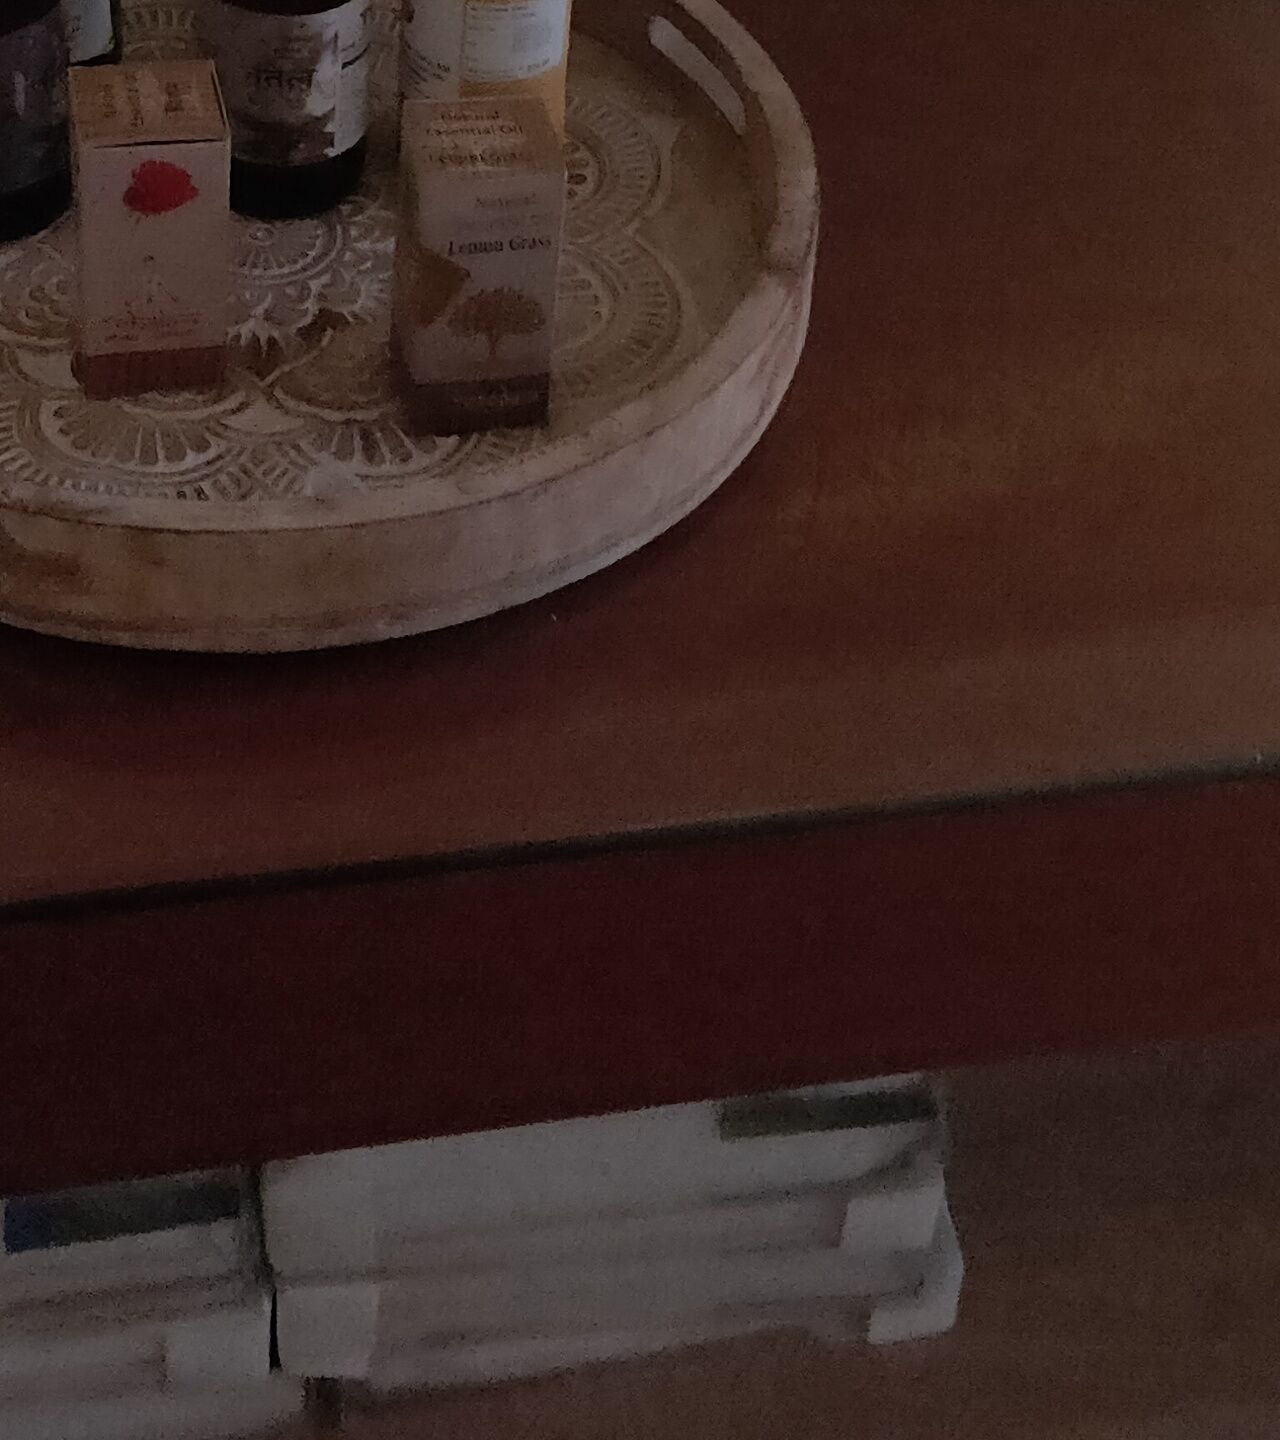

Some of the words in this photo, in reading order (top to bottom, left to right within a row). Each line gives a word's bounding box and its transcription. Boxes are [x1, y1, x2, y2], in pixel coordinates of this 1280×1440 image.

[499, 124, 524, 136] Oil
[447, 239, 505, 257] Lemon
[508, 236, 553, 252] Grass
